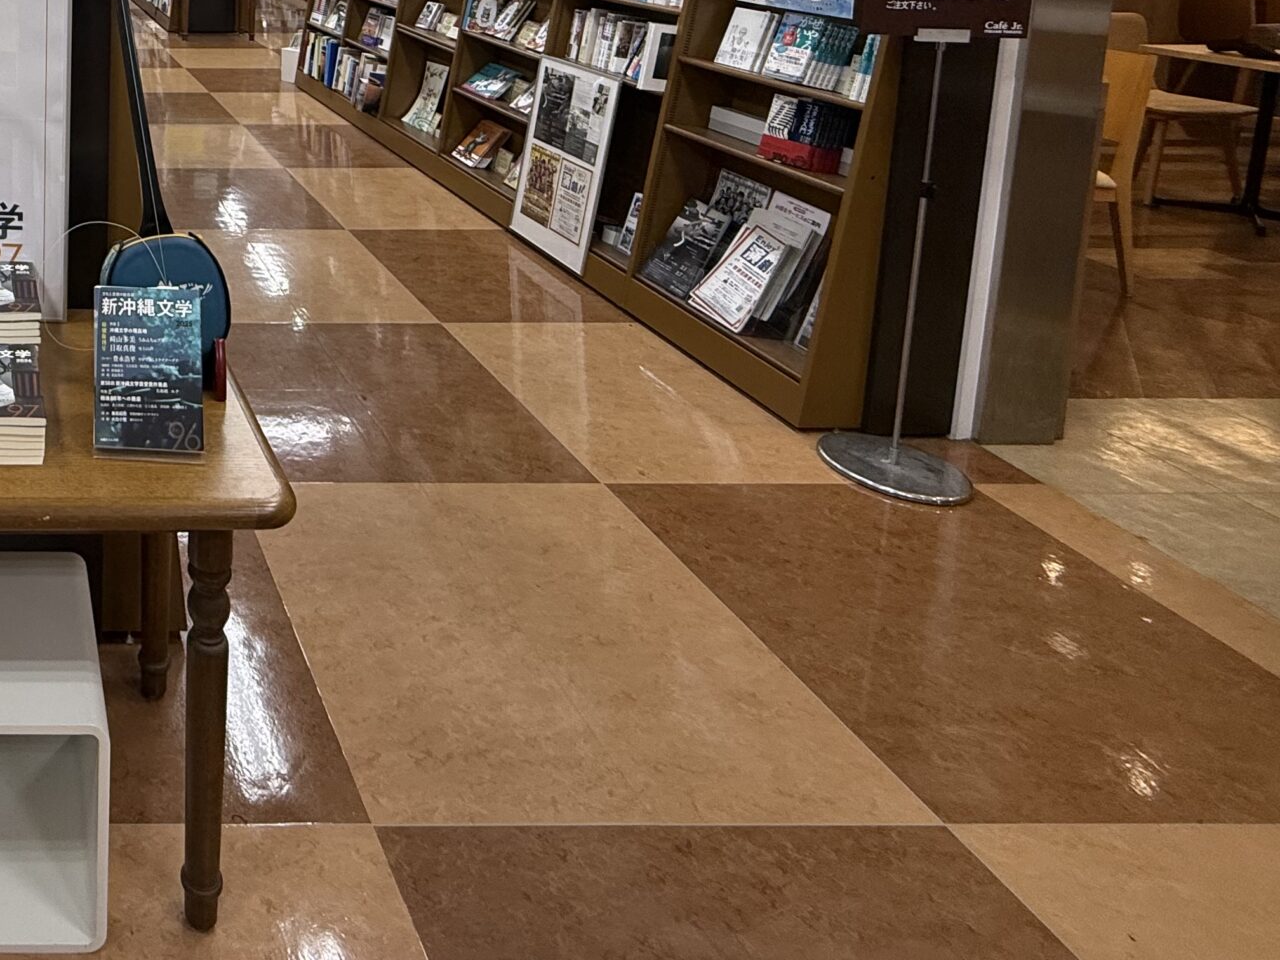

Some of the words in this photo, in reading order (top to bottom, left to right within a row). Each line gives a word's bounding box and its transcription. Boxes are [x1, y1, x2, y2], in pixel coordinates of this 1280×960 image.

[886, 1, 937, 11] ご注文下さい。
[984, 20, 1008, 30] Café
[1010, 21, 1023, 30] Jr.
[101, 297, 192, 317] 新沖縄文学
[168, 421, 200, 450] 96
